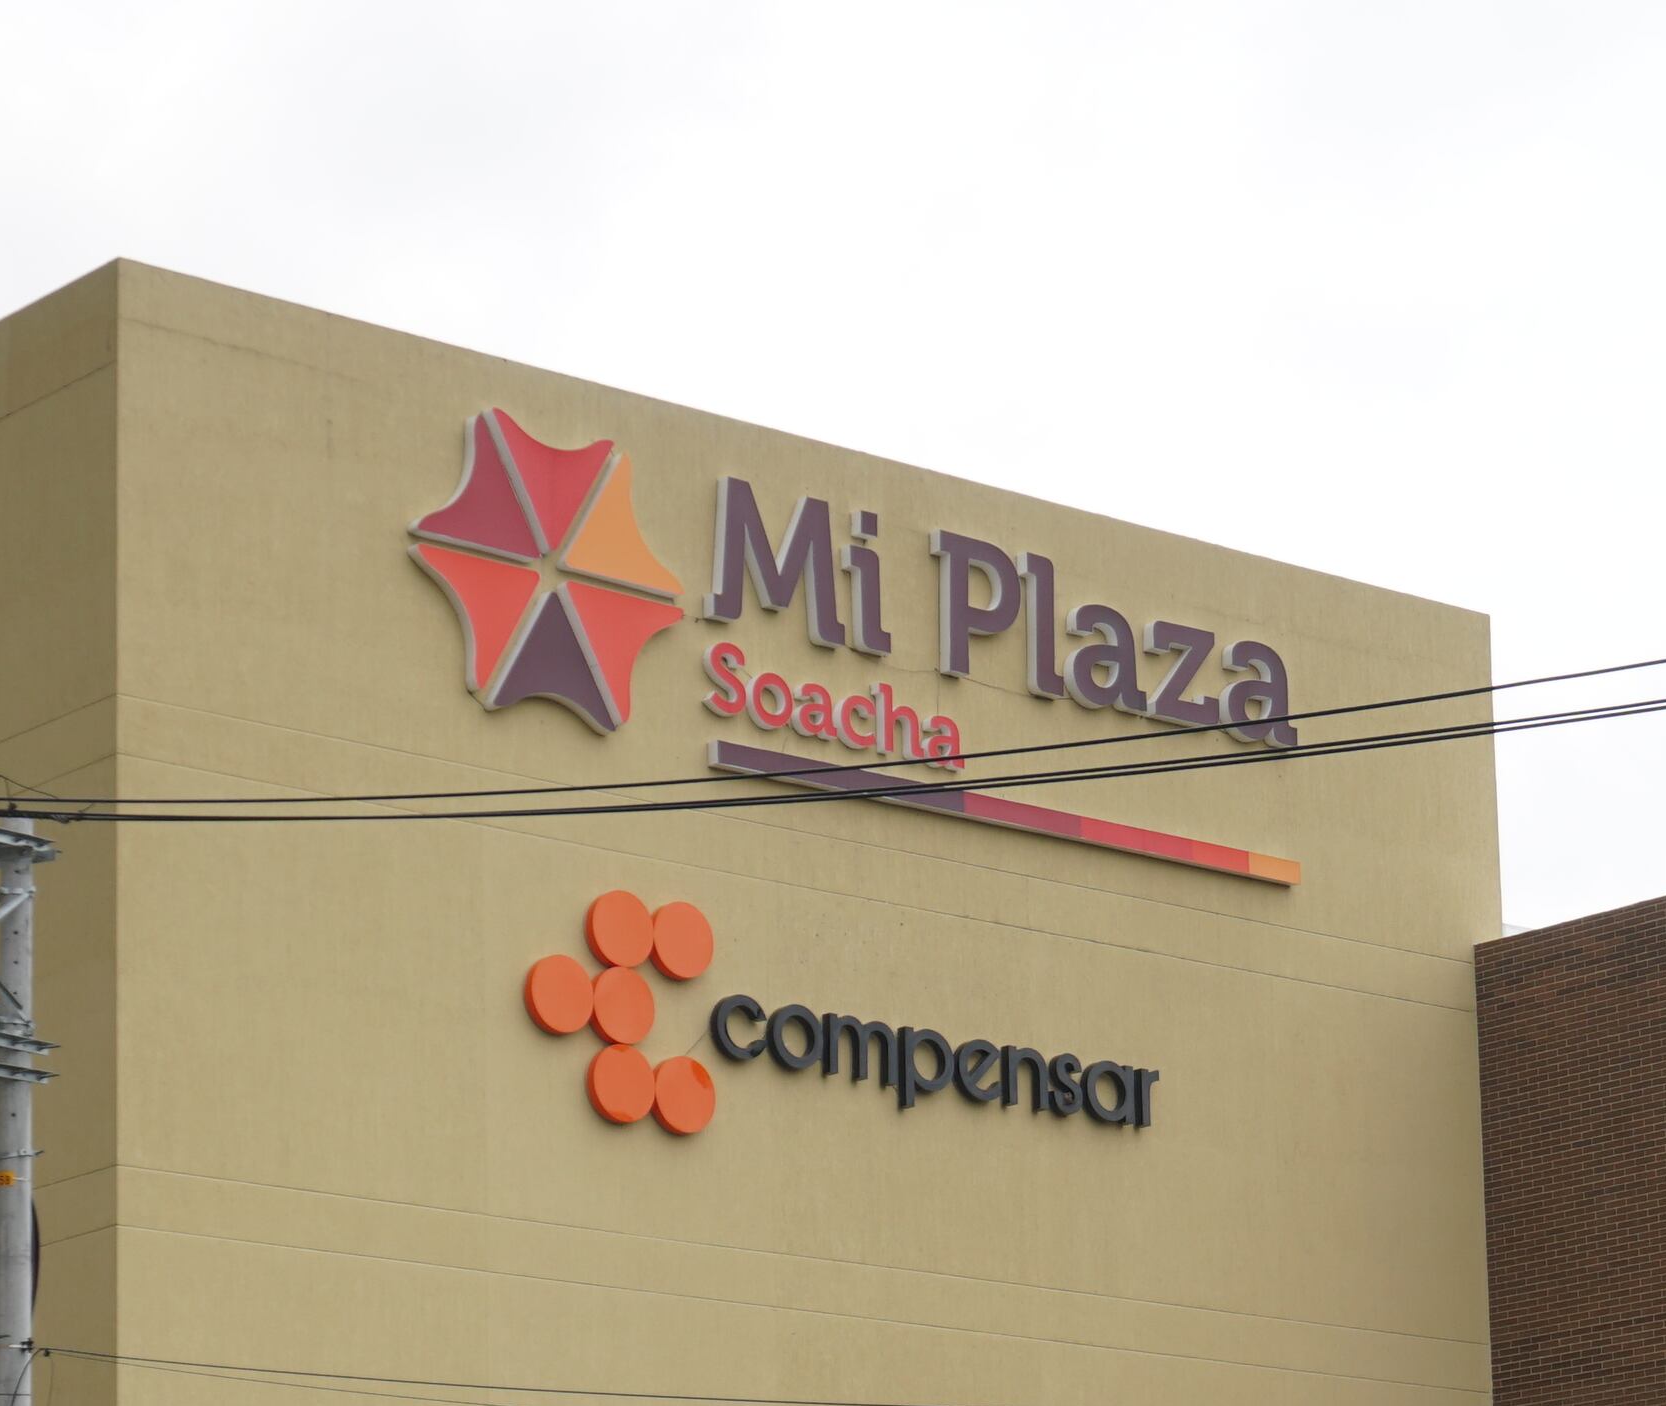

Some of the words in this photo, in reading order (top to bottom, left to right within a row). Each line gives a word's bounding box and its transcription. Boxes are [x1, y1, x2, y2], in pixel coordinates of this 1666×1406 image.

[704, 476, 891, 656] Mi
[930, 529, 1298, 748] Plaza
[704, 642, 965, 771] Soacha
[711, 994, 1159, 1128] compensar
